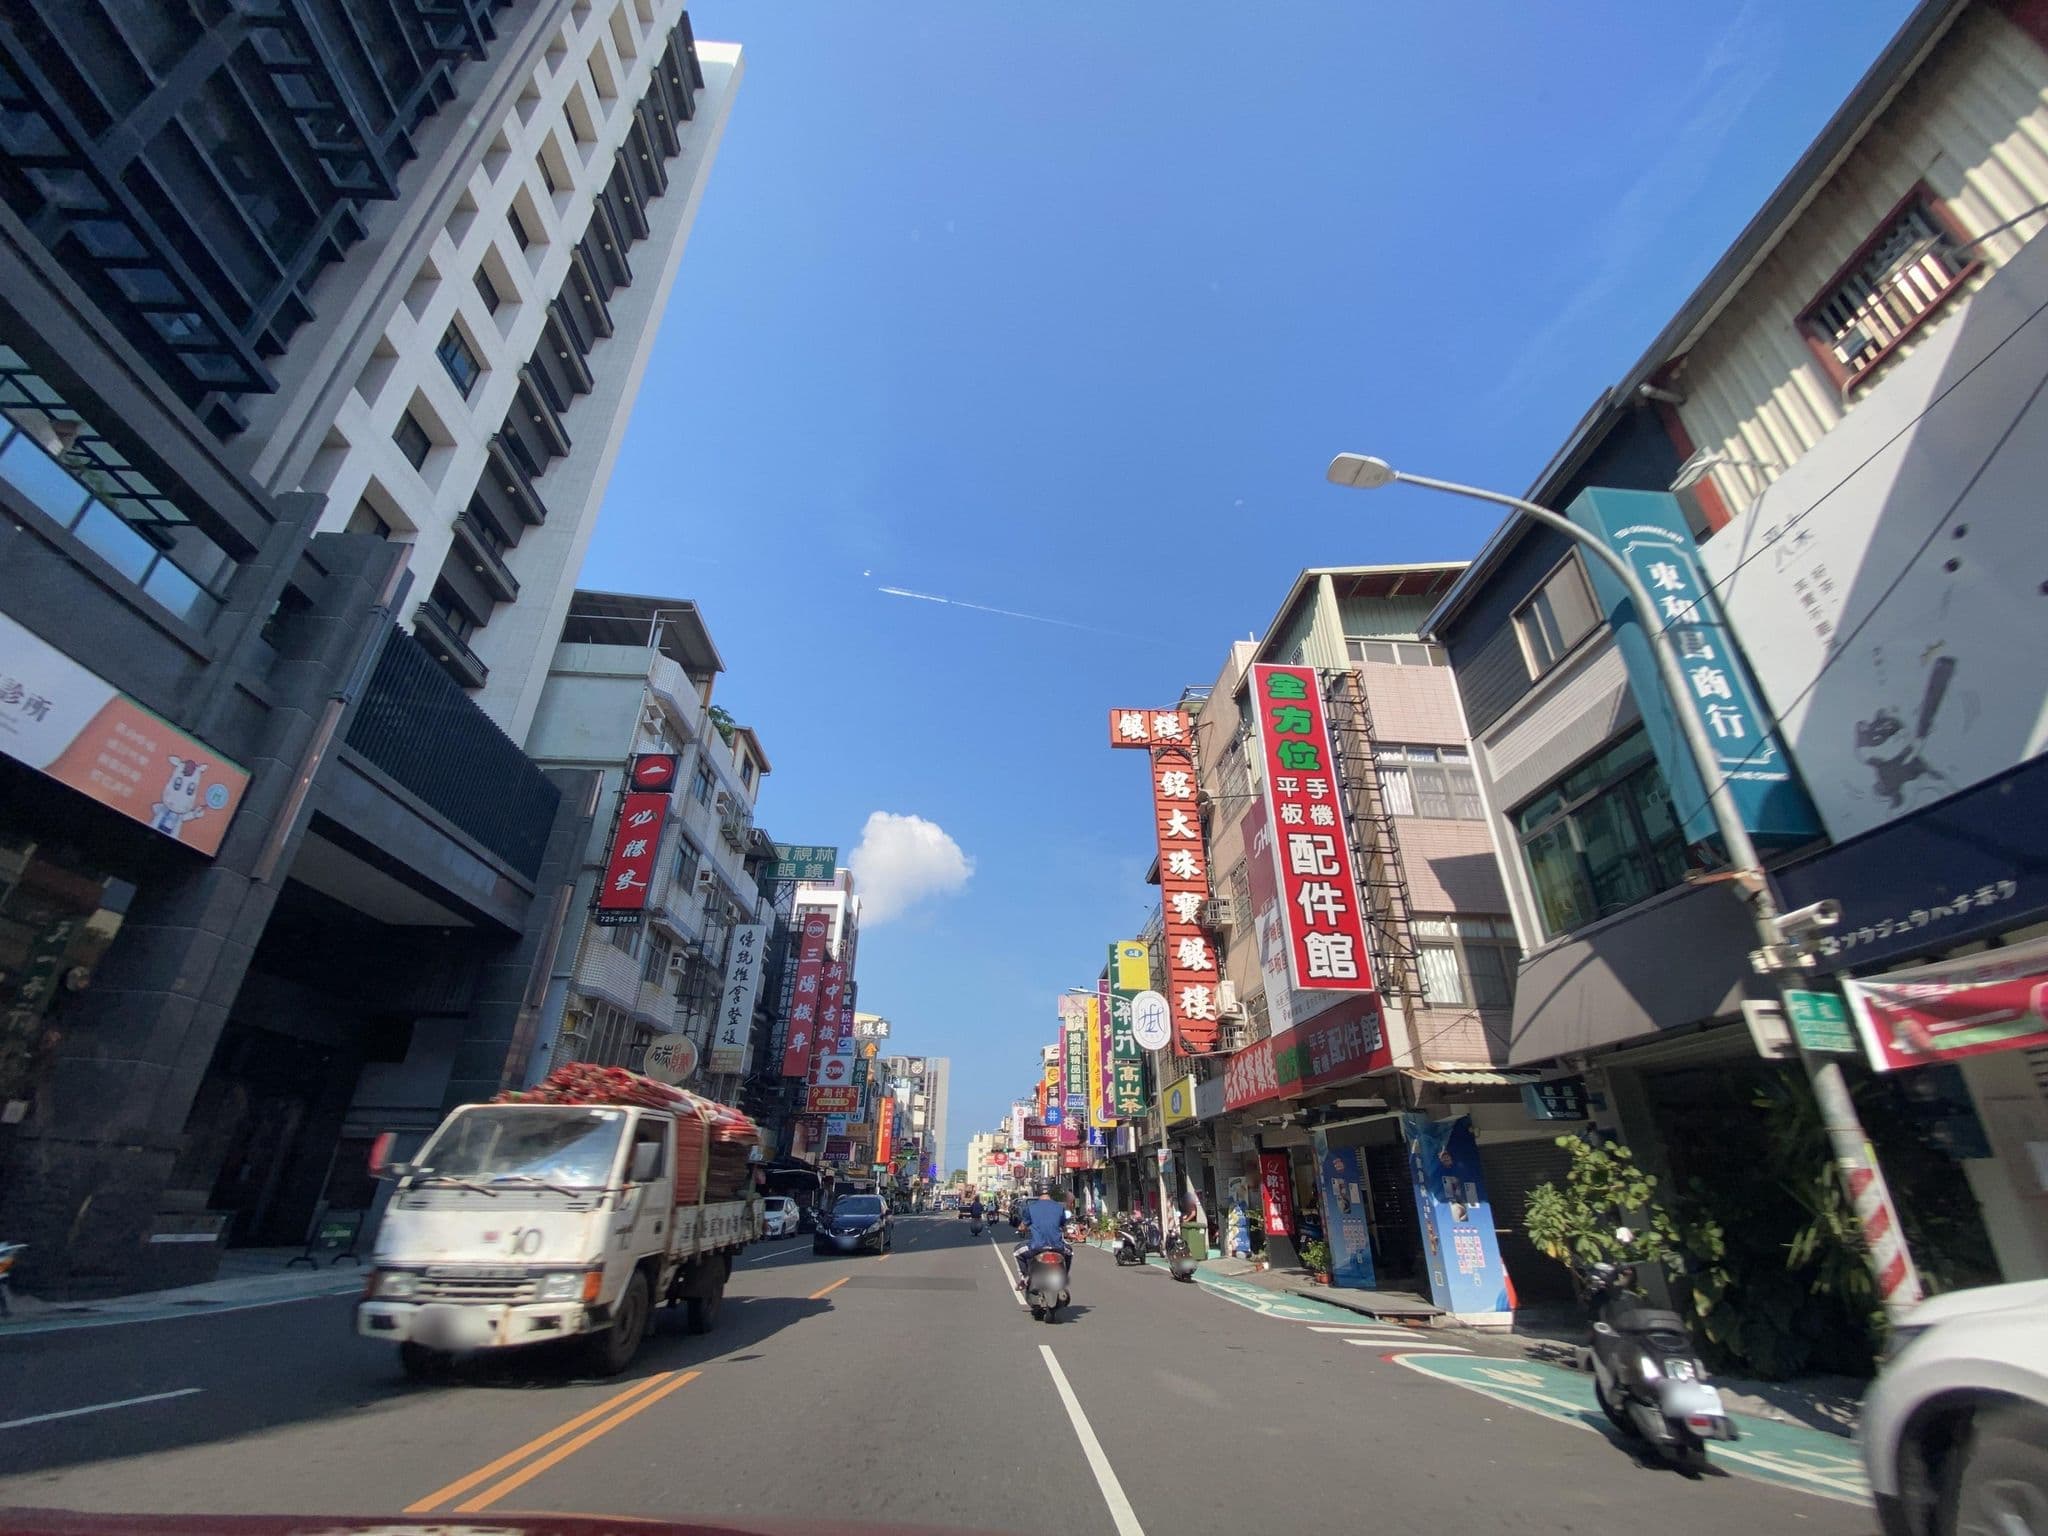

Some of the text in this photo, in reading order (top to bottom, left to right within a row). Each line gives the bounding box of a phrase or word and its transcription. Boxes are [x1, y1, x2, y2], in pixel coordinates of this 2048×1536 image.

[1118, 712, 1183, 741] 銀樓
[1267, 672, 1322, 771] 全方位
[614, 809, 659, 891] 必勝客
[777, 863, 824, 878] 眼鏡
[1288, 833, 1359, 979] 配件館
[788, 948, 822, 1053] 三陽機車
[1326, 1012, 1385, 1065] 配件館
[1117, 1065, 1143, 1114] 高山茶
